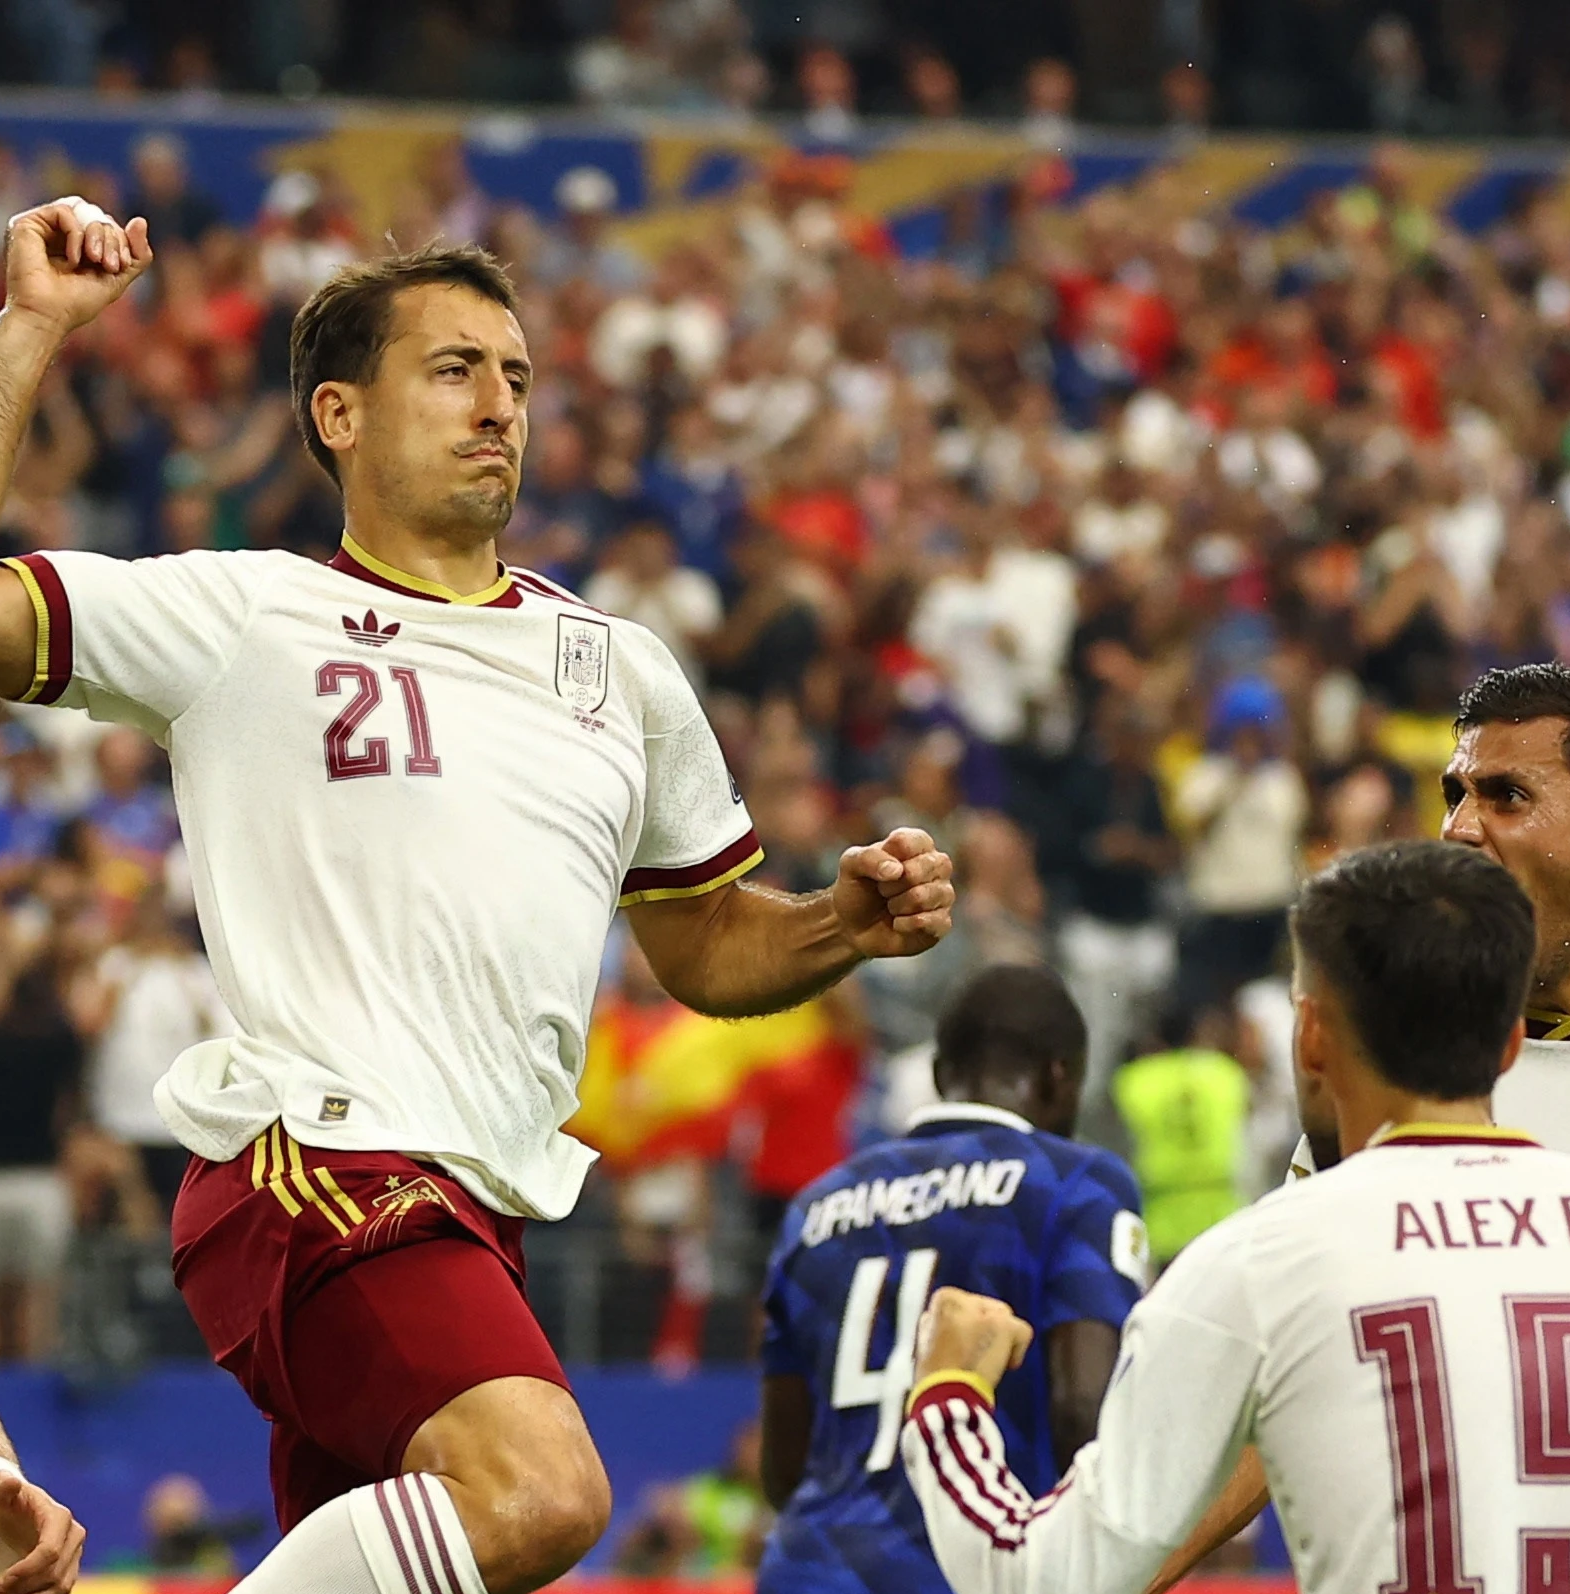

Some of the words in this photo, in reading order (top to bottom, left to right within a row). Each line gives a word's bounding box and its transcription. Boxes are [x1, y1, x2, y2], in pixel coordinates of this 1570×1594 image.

[315, 659, 442, 782] 21
[801, 1158, 1027, 1248] UPAMECANO
[1394, 1197, 1546, 1251] ALEX
[832, 1248, 938, 1474] 4
